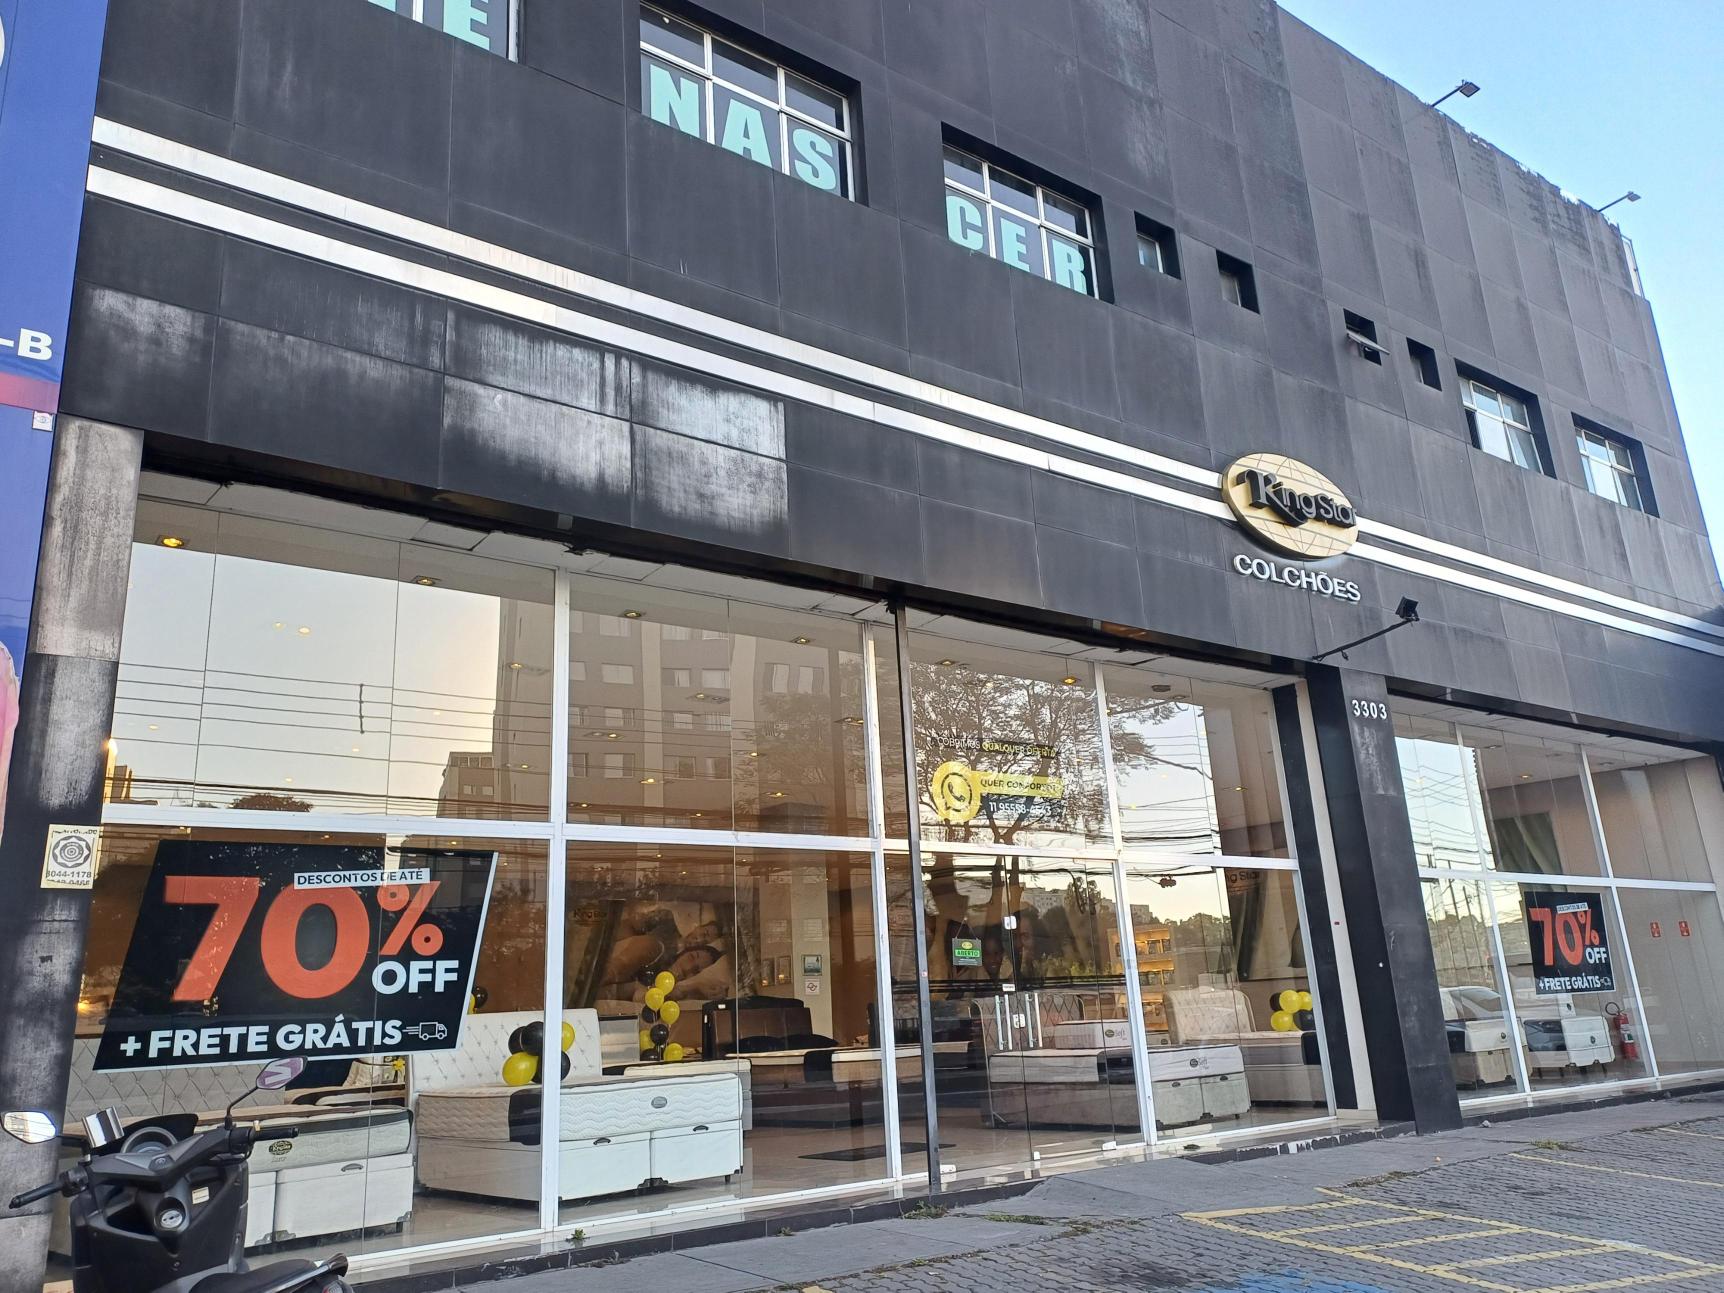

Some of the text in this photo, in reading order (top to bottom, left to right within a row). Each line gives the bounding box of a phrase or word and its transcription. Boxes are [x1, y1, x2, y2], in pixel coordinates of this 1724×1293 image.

[1234, 554, 1361, 601] COLCHÕES
[1352, 699, 1387, 720] 3303
[982, 741, 1025, 755] QUALQUER
[980, 779, 1004, 788] QUER
[988, 801, 997, 812] 11
[297, 868, 423, 885] DESCONTOS DE ATÉ
[163, 875, 444, 1003] 70%
[1528, 908, 1599, 966] 70%
[1585, 947, 1608, 964] OFF
[372, 960, 459, 994] OFF
[1544, 976, 1571, 991] FRETE
[1571, 972, 1600, 989] GRÁTIS
[148, 1025, 269, 1058] FRETE
[276, 1013, 402, 1051] GRÁTIS
